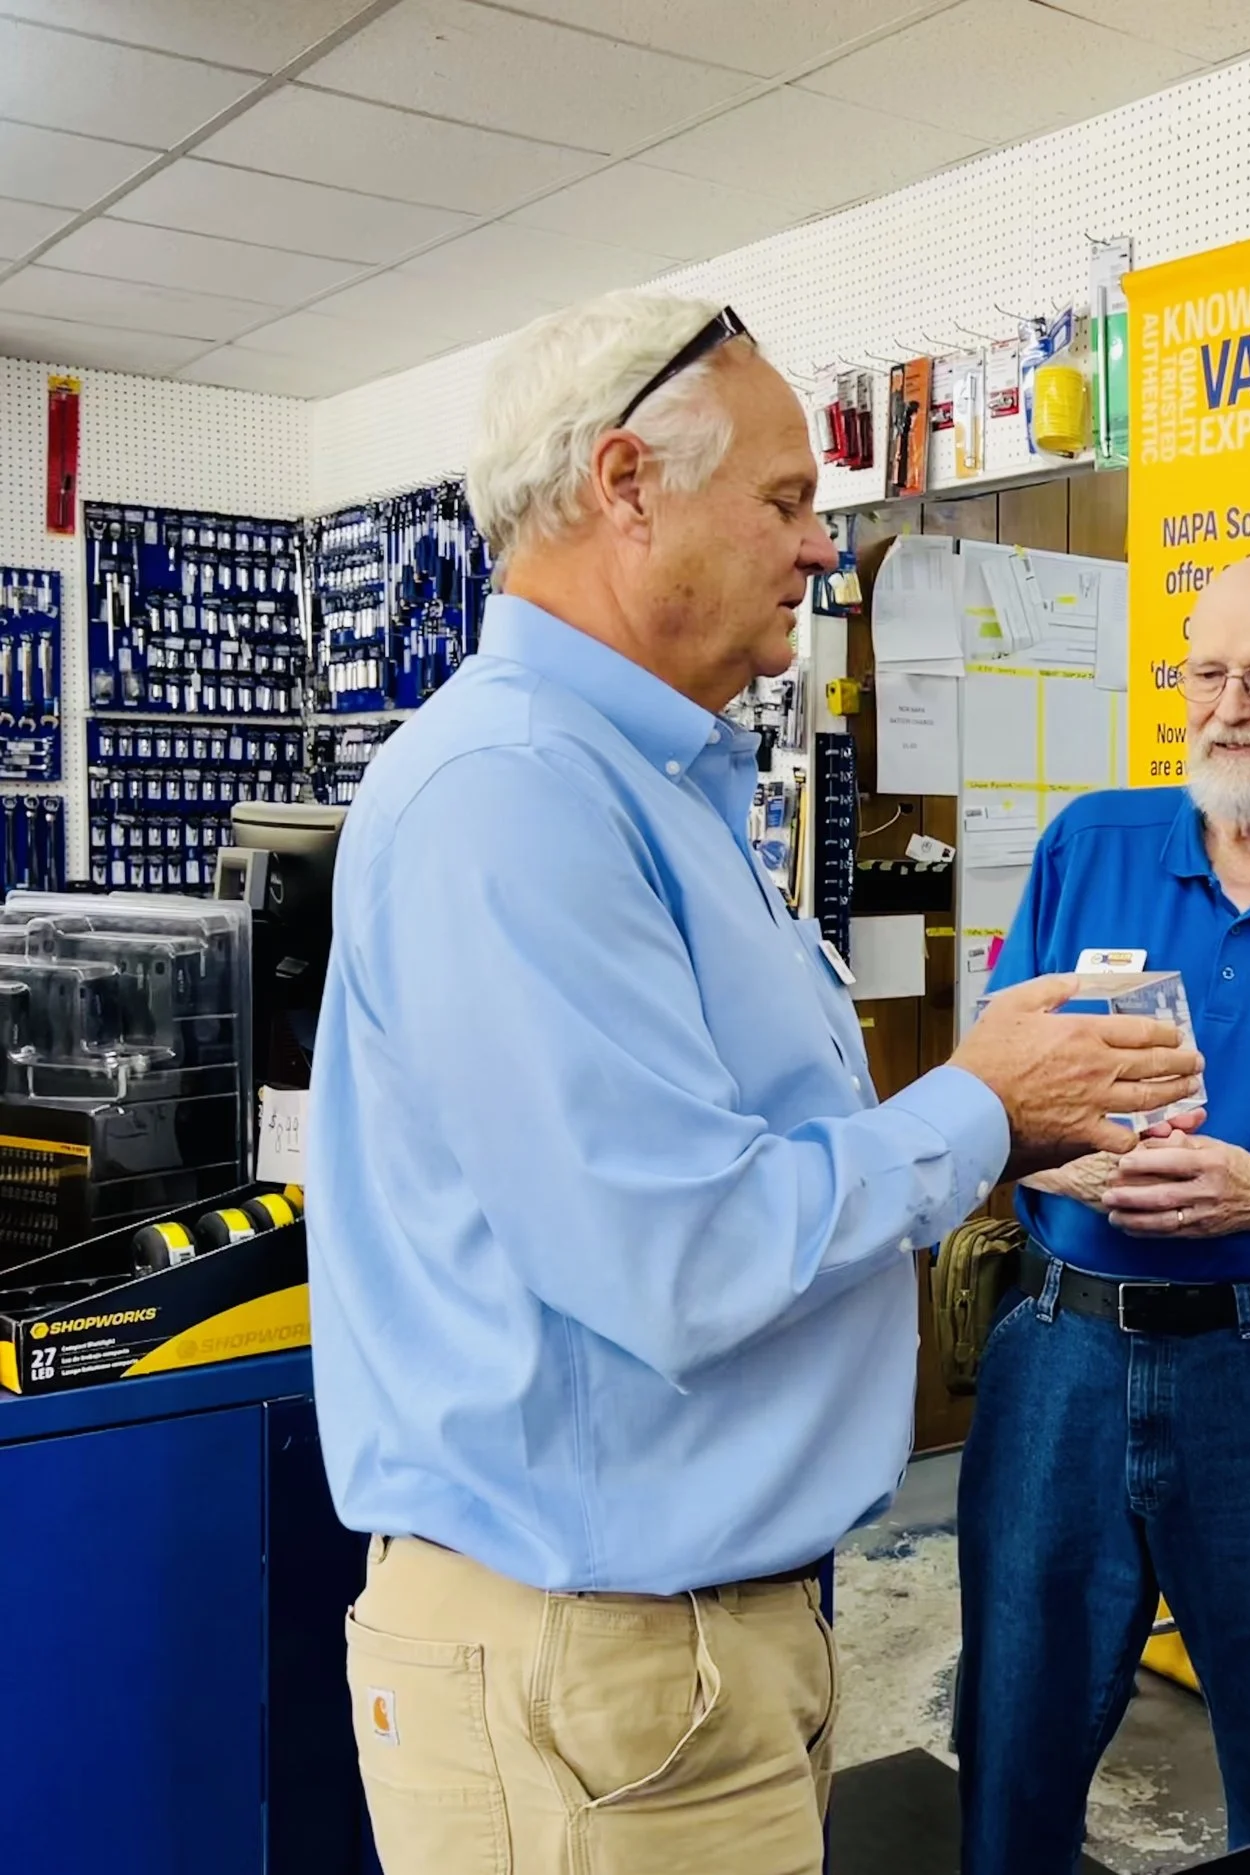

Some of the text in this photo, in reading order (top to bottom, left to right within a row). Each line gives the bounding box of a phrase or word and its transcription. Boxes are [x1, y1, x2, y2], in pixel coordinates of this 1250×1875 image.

[1141, 314, 1160, 465] AUTHENTIC
[1179, 347, 1197, 457] QUALITY
[1161, 352, 1178, 462] TRUSTED
[1163, 511, 1218, 547] NAPA
[1166, 560, 1214, 595] offer
[1157, 723, 1187, 743] Now
[1150, 760, 1171, 776] are
[50, 1307, 157, 1335] SHOPWORKS
[201, 1321, 309, 1354] SHOPWOR
[31, 1347, 57, 1368] 27
[31, 1366, 55, 1381] LED
